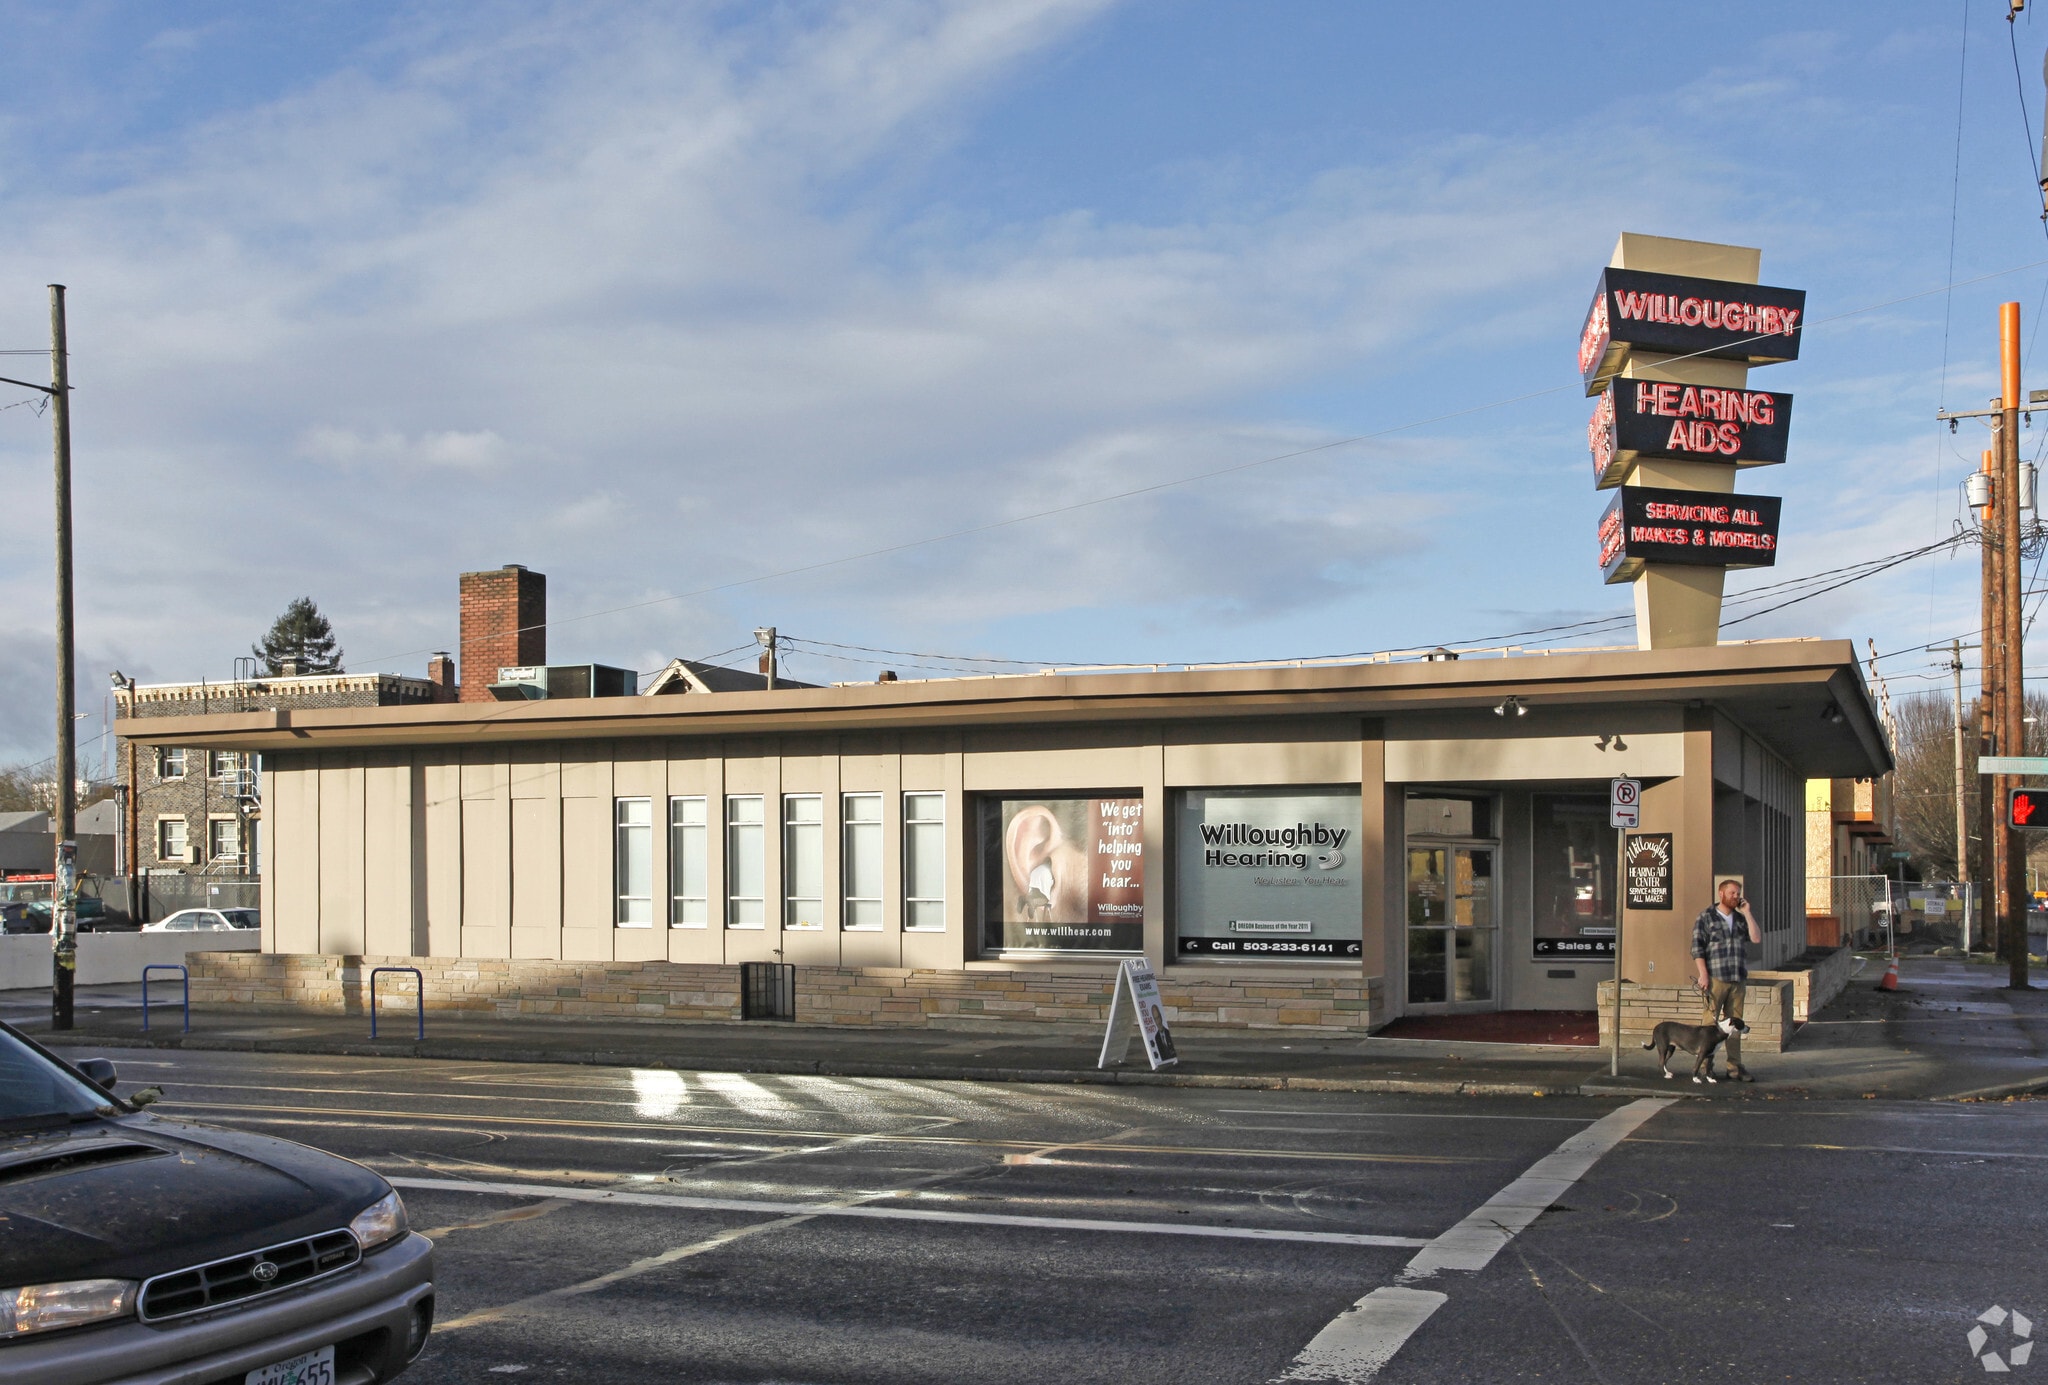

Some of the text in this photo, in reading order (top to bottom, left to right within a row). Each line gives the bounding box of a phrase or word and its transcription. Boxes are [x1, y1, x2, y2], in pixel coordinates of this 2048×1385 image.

[1614, 289, 1800, 337] WILLOUGHBY
[1636, 381, 1775, 425] HEARING
[1666, 418, 1742, 455] AIDS
[1645, 502, 1764, 526] SERVICING ALL
[1631, 526, 1775, 550] MAKES & MODELS
[1100, 802, 1143, 819] We get
[1200, 823, 1347, 849] Willoughby
[1098, 839, 1142, 856] helping
[1626, 835, 1669, 866] Willoughby
[1111, 860, 1132, 873] you
[1205, 849, 1308, 870] Hearing
[1102, 873, 1140, 888] hear...
[1629, 866, 1667, 878] HEARING AID
[1635, 876, 1660, 887] CENTER
[1629, 887, 1648, 895] SERVICE
[1651, 887, 1667, 895] REPAIR
[1632, 895, 1664, 903] ALL MAKES
[1097, 903, 1143, 912] Willoughby
[1025, 926, 1112, 937] www.willhear.com
[1212, 941, 1334, 953] Call 503-233-6141
[1557, 942, 1592, 950] Sales
[1595, 942, 1605, 950] &
[274, 1356, 308, 1373] Oregon
